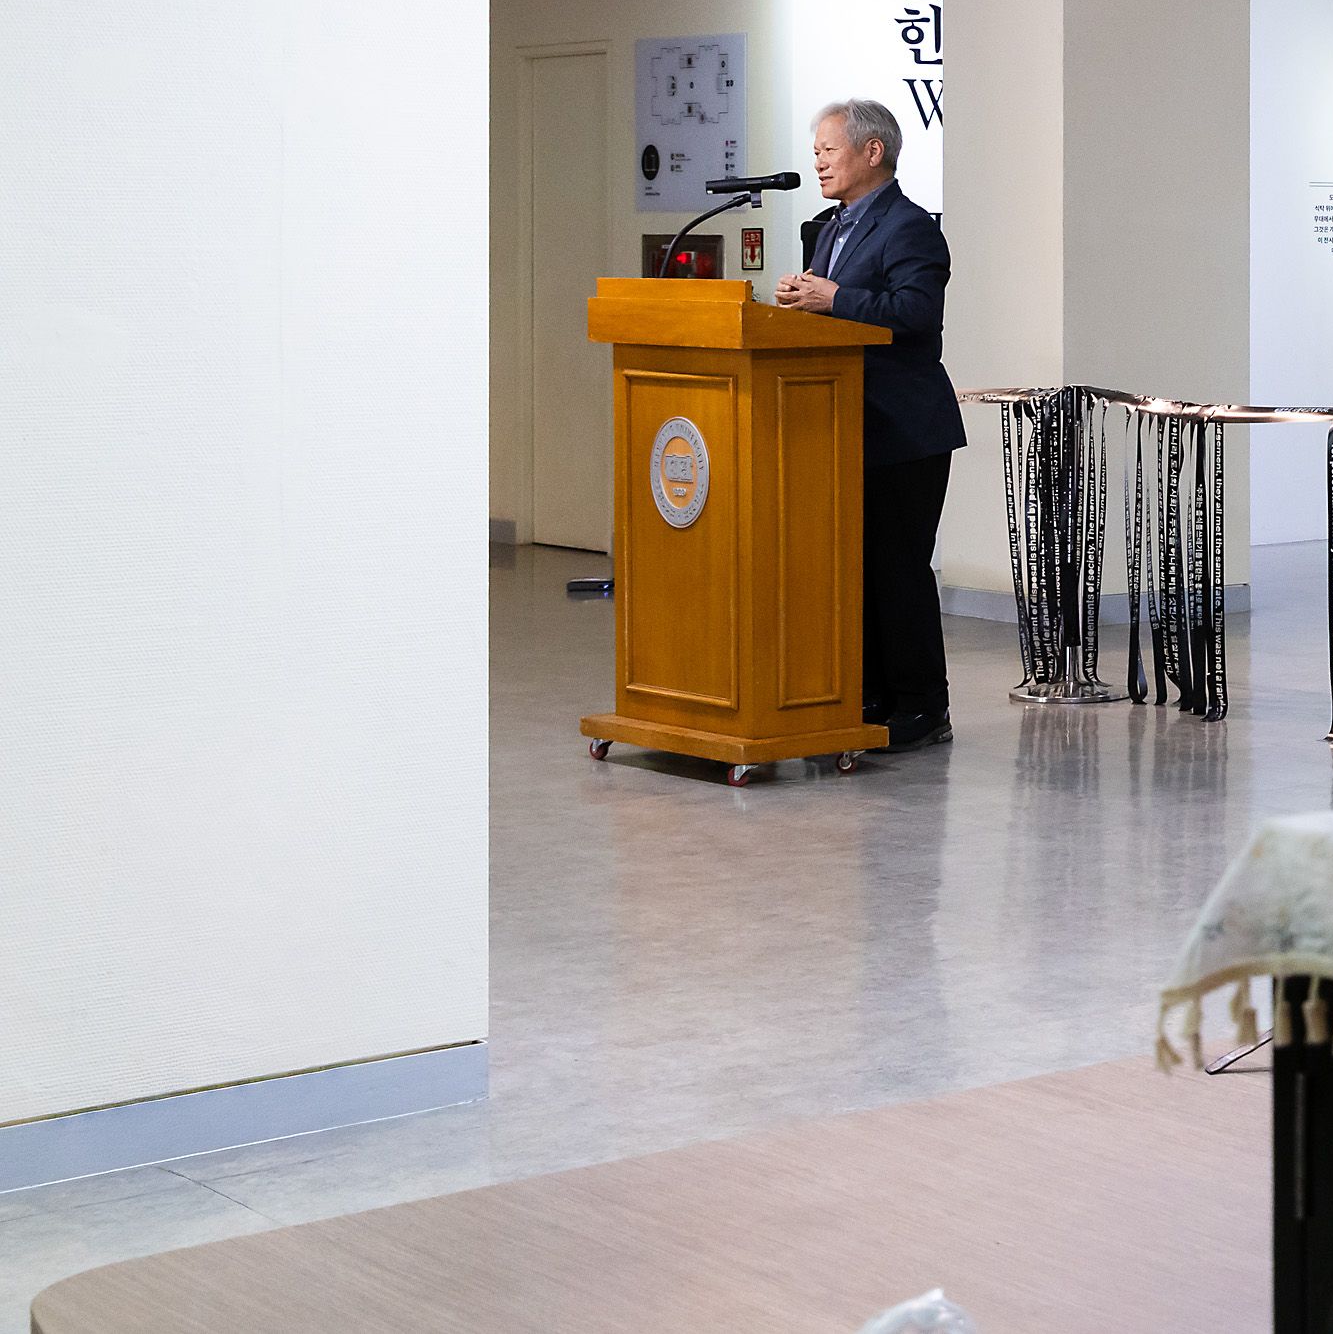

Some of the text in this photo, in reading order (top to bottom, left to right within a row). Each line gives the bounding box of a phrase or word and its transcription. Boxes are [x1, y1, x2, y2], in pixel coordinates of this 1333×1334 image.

[1027, 458, 1036, 501] personal
[1027, 502, 1036, 514] by
[1028, 516, 1038, 551] shaped
[1029, 553, 1036, 561] is
[1087, 544, 1096, 580] society.
[1029, 563, 1038, 603] disposal
